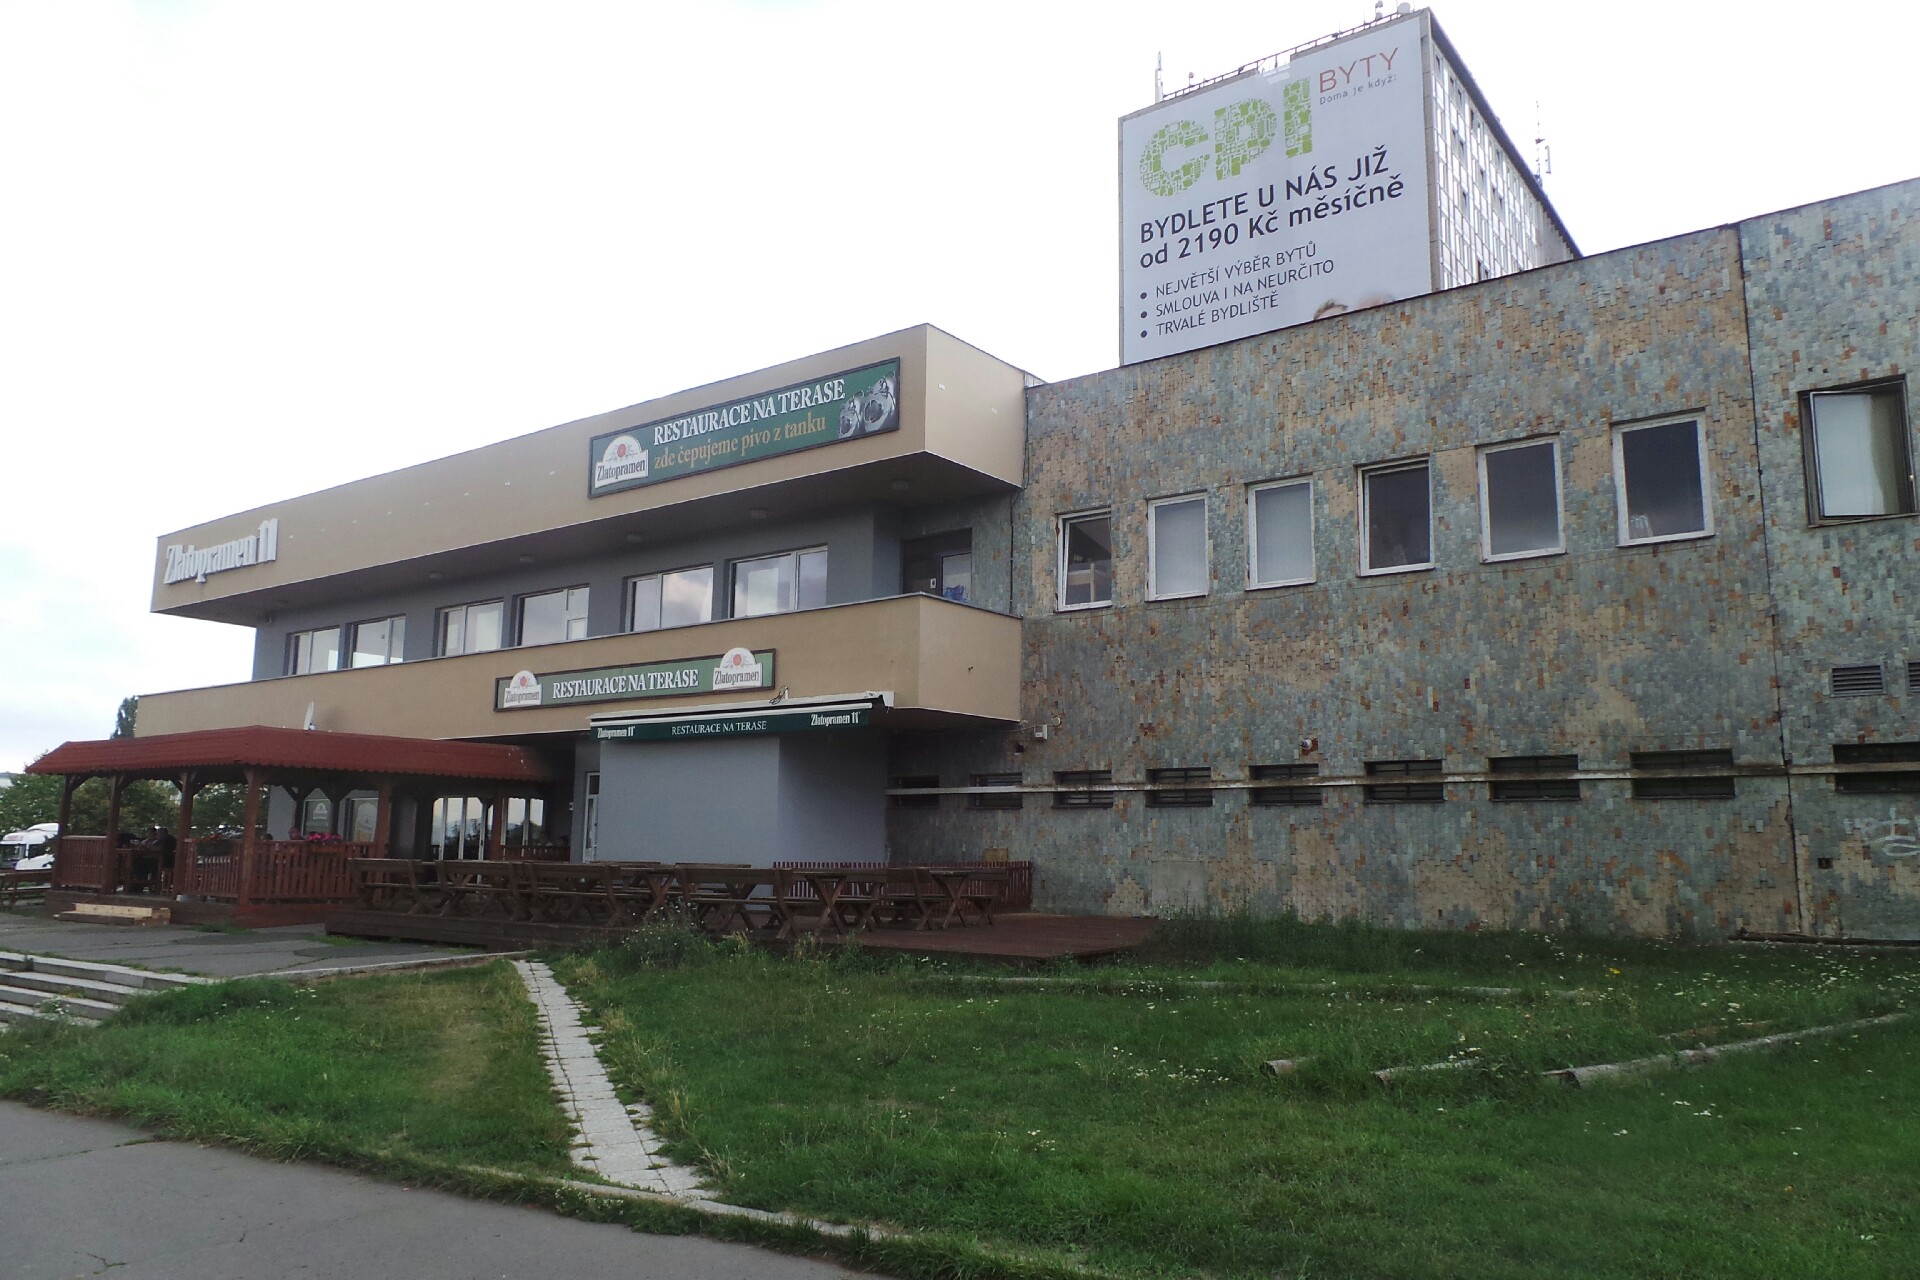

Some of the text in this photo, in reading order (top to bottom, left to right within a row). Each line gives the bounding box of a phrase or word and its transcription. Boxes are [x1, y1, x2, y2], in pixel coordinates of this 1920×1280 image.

[1319, 47, 1399, 93] BYTY
[1319, 91, 1348, 105] Doma
[1353, 86, 1364, 96] je
[1138, 76, 1313, 198] CPI
[1140, 144, 1389, 244] BYDLETE U NÁS JIŽ
[1140, 173, 1404, 269] od 2190 Kč měsíčně
[1156, 240, 1316, 298] NEJVĚTŠÍ VÝBĚR BYTŮ
[1156, 259, 1334, 317] SMLOUVA I NA NEURČITO
[1156, 289, 1279, 336] TRVALÉ BYDLIŠTĚ
[653, 379, 846, 446] RESTAURACE NA TERASE
[654, 410, 826, 470] zde čepujeme pivo z tanku
[597, 459, 646, 482] Zlatopramen
[505, 690, 540, 705] Zlatopramen
[552, 669, 699, 699] RESTAURACE NA TERASE
[714, 668, 760, 686] Zlatopramen
[597, 727, 628, 739] Zlatopramen
[671, 720, 768, 736] RESTAURACE NA TERASE
[810, 713, 850, 727] Zlatopramen
